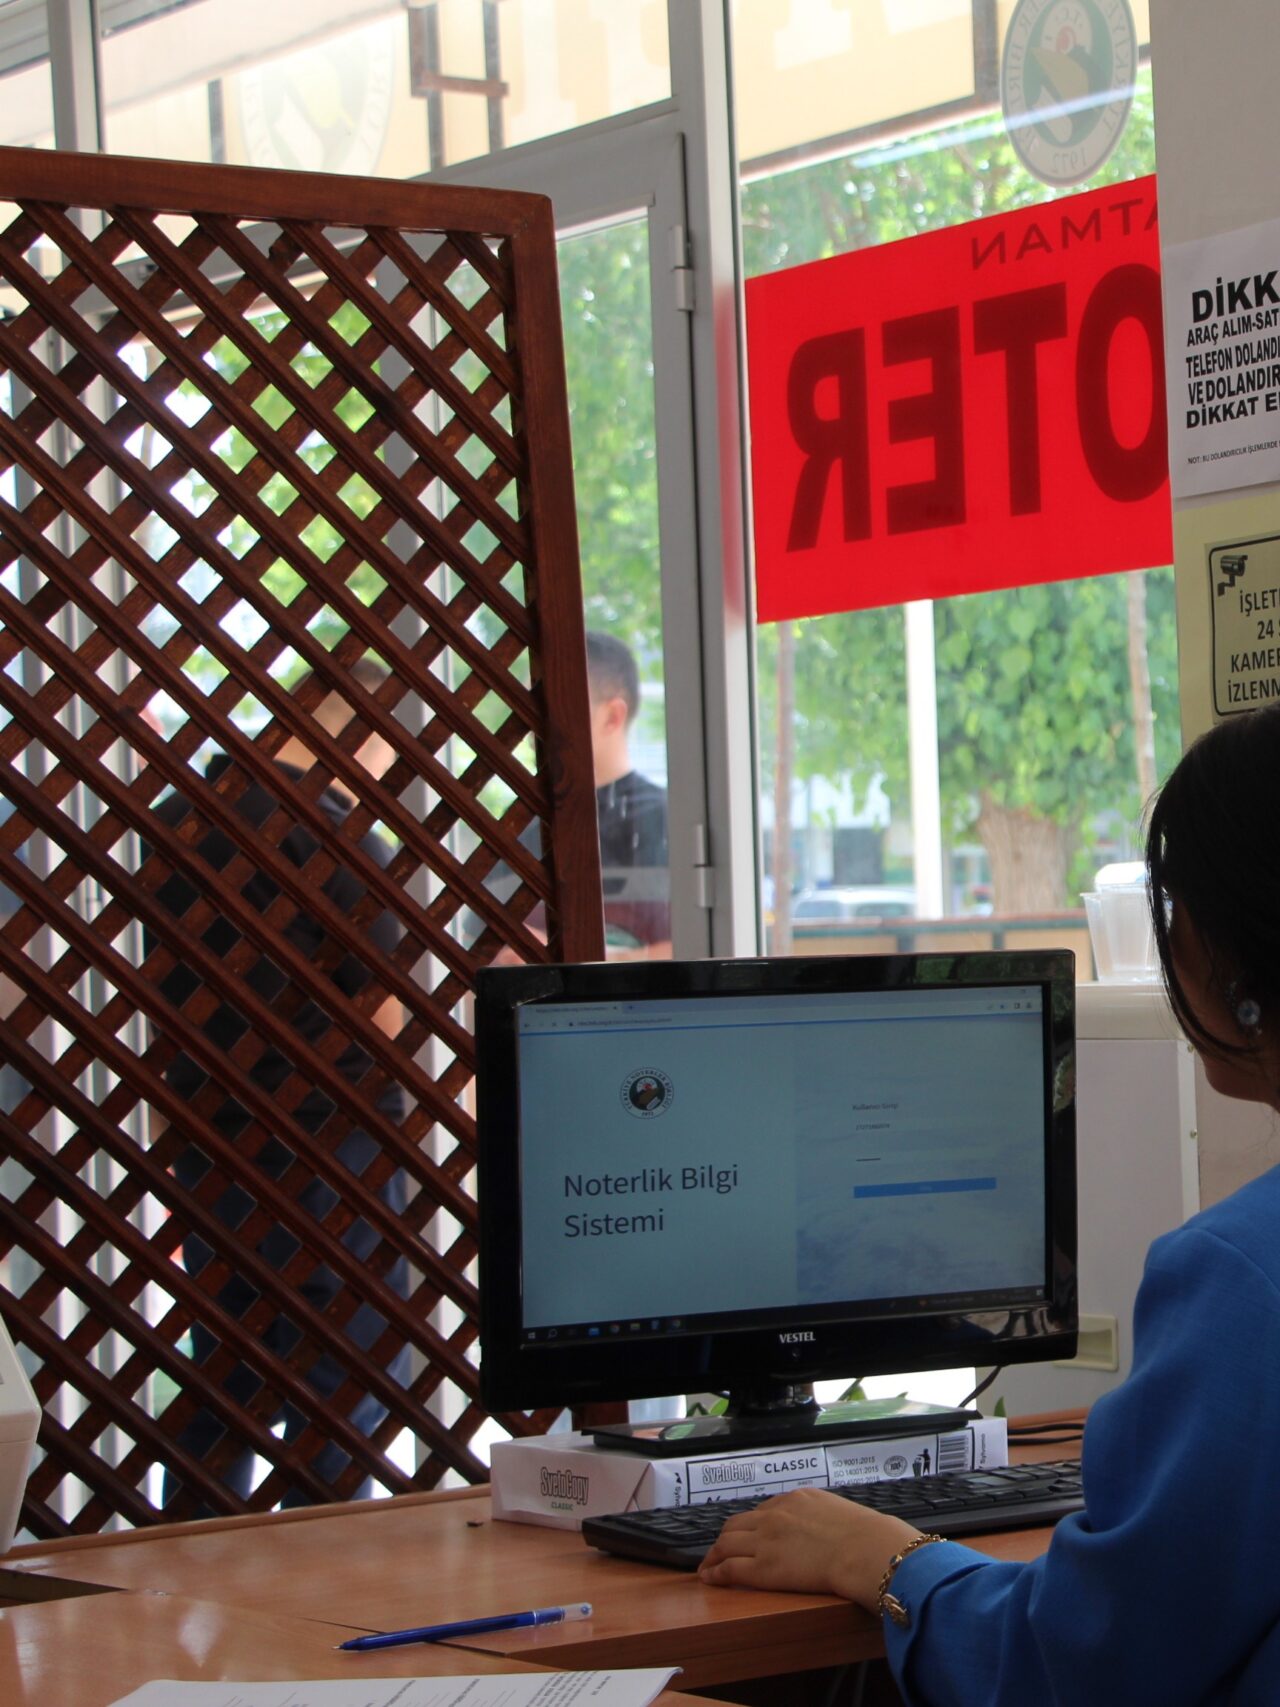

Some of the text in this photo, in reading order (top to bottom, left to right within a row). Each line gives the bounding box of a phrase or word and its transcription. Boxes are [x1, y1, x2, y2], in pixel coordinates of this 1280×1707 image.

[1187, 322, 1219, 345] ARAÇ
[1186, 347, 1233, 378] TELEFON
[1188, 381, 1204, 405] VE
[1186, 397, 1259, 429] DİKKAT
[1257, 619, 1274, 640] 24
[564, 1164, 739, 1198] Noterlik Bilgi
[564, 1208, 664, 1238] Sistemi
[779, 1331, 816, 1344] VESTEL
[702, 1457, 818, 1485] SvetoCopy CLASSIC
[541, 1467, 589, 1505] SvetoCopy
[551, 1501, 574, 1512] CLASSIC
